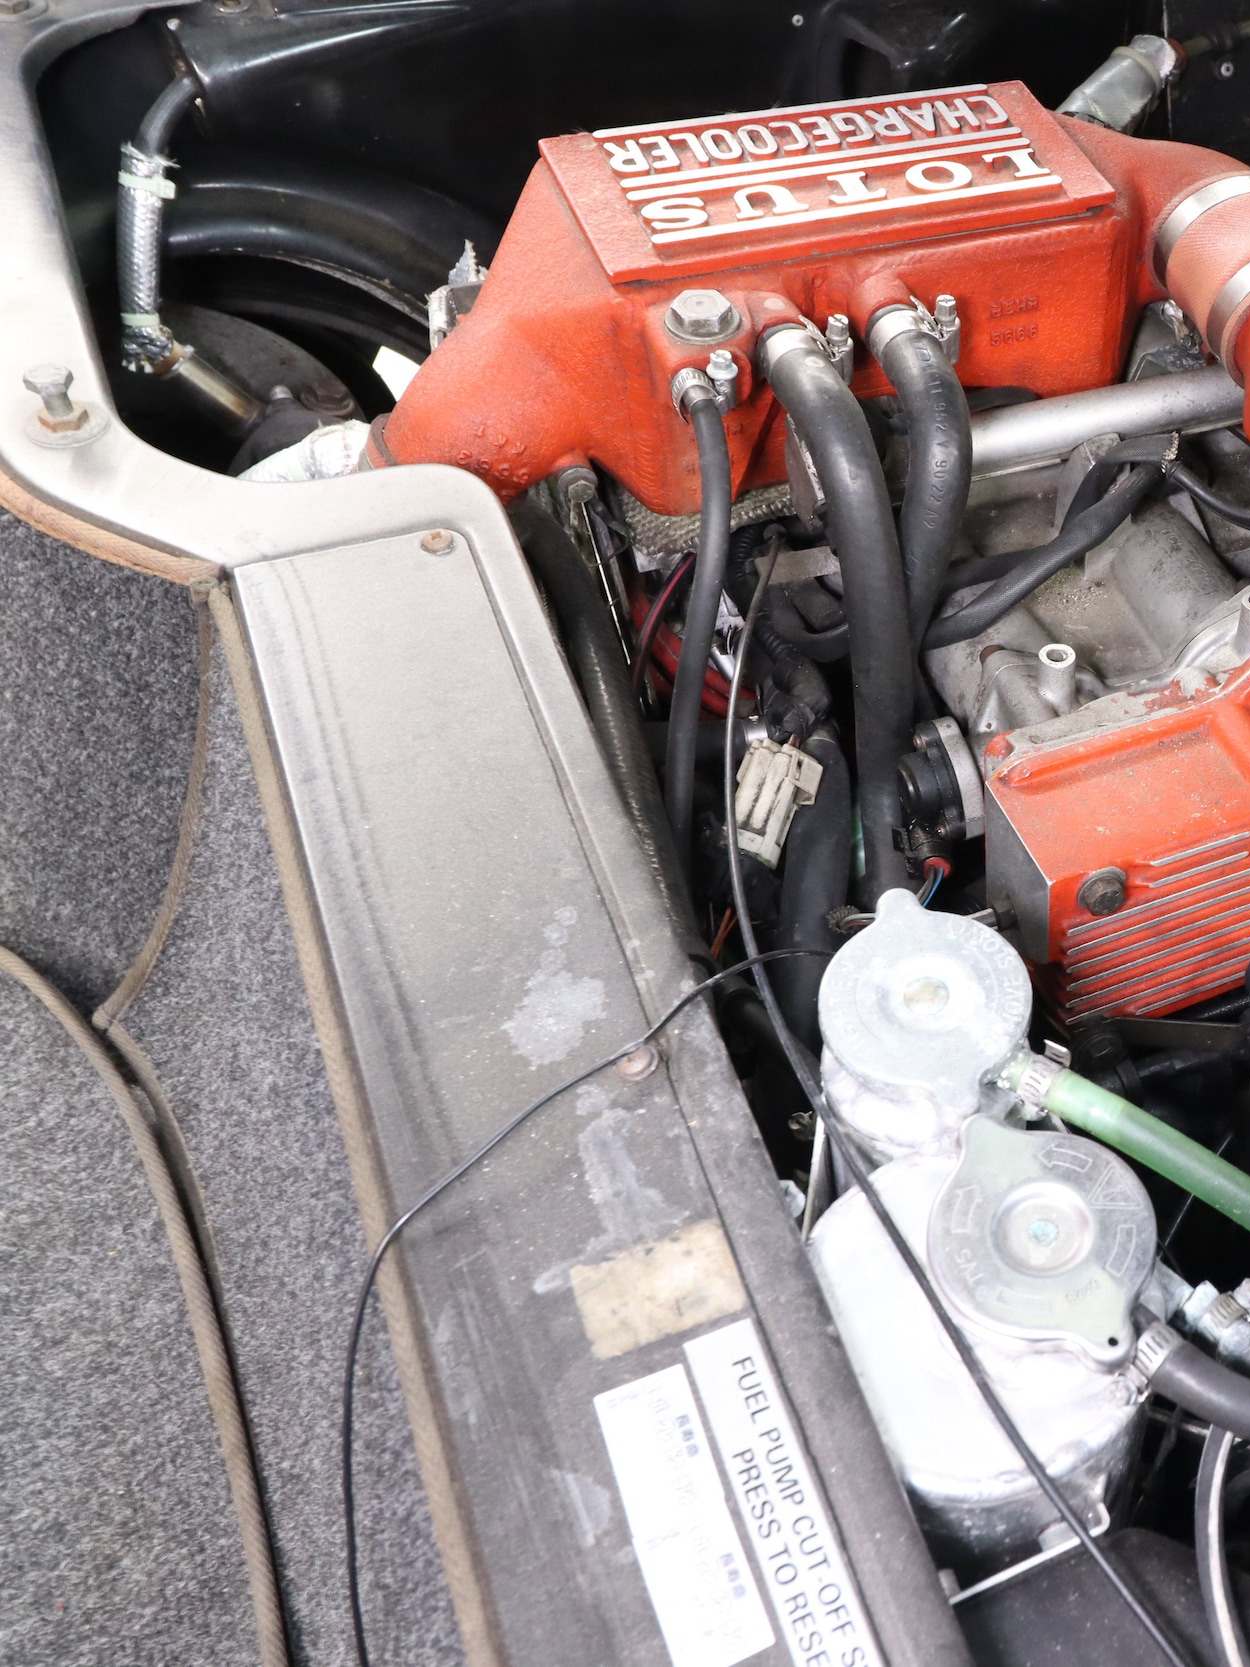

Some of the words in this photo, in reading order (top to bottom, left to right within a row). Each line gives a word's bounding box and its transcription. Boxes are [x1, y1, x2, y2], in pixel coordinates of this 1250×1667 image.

[602, 95, 1009, 174] CHARGECOOLER
[640, 147, 1051, 231] LOTUS
[731, 1355, 771, 1425] FUEL
[758, 1426, 805, 1506] PUMP
[841, 1647, 869, 1667] S
[731, 1447, 782, 1540] PRESS
[768, 1541, 799, 1586] TO
